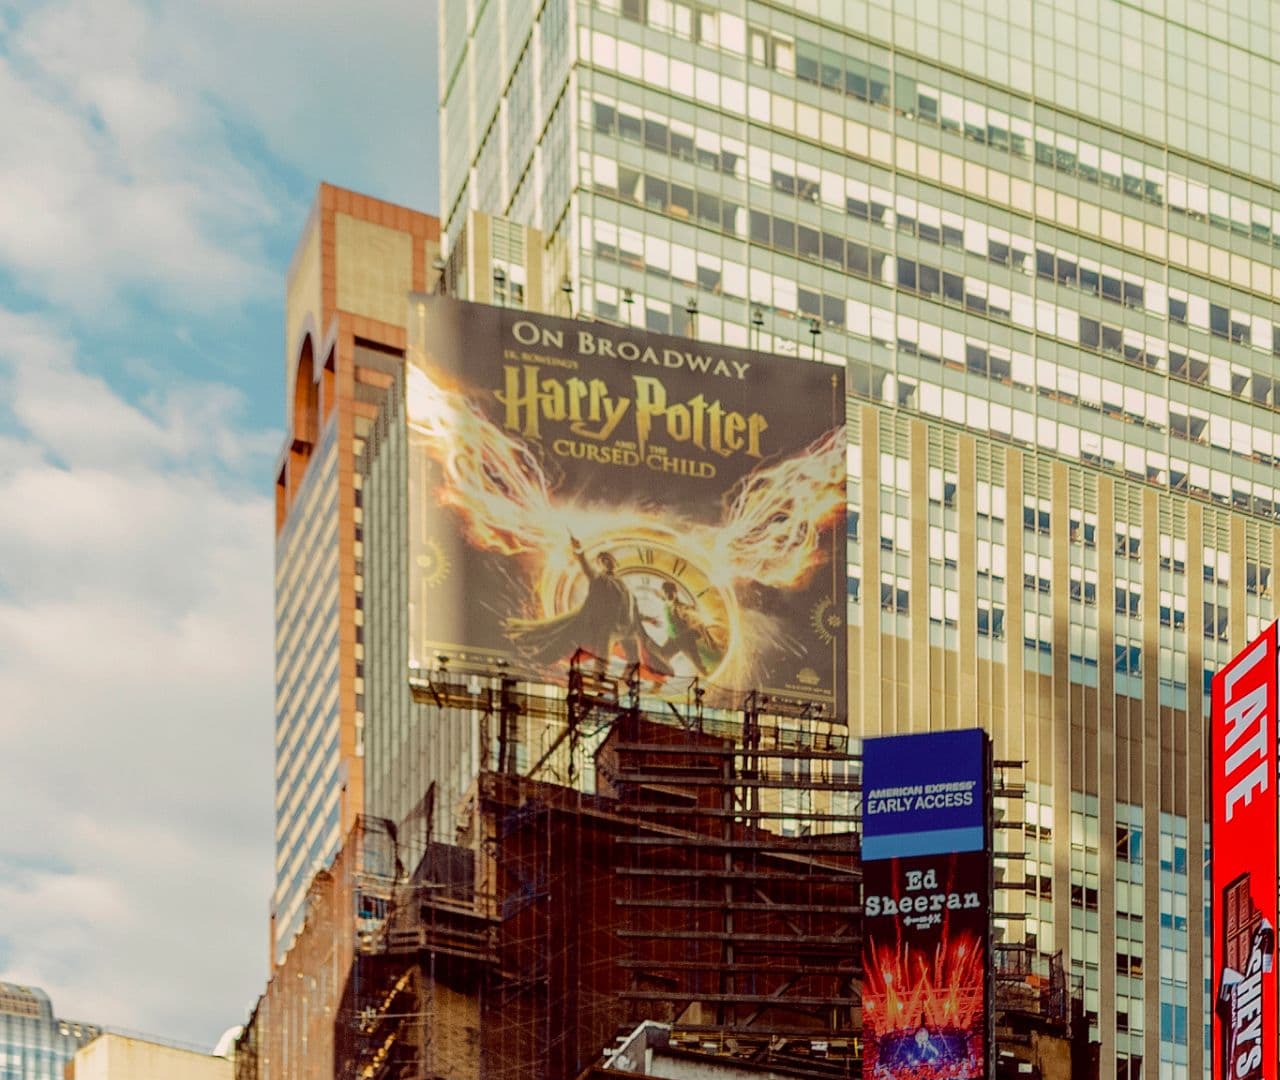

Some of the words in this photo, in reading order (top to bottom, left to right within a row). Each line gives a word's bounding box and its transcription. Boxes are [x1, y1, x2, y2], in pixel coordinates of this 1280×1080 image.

[493, 364, 630, 441] Harry
[632, 375, 769, 460] Potter
[615, 440, 635, 449] AND
[553, 439, 640, 466] CURSED
[646, 454, 717, 478] CHILD
[1223, 638, 1269, 823] LATE
[868, 785, 922, 800] AMERICAN
[925, 780, 976, 794] EXPRESS
[867, 798, 913, 815] EARLY
[915, 792, 973, 810] ACCESS
[905, 869, 938, 891] Ed
[865, 892, 981, 917] Sheeran
